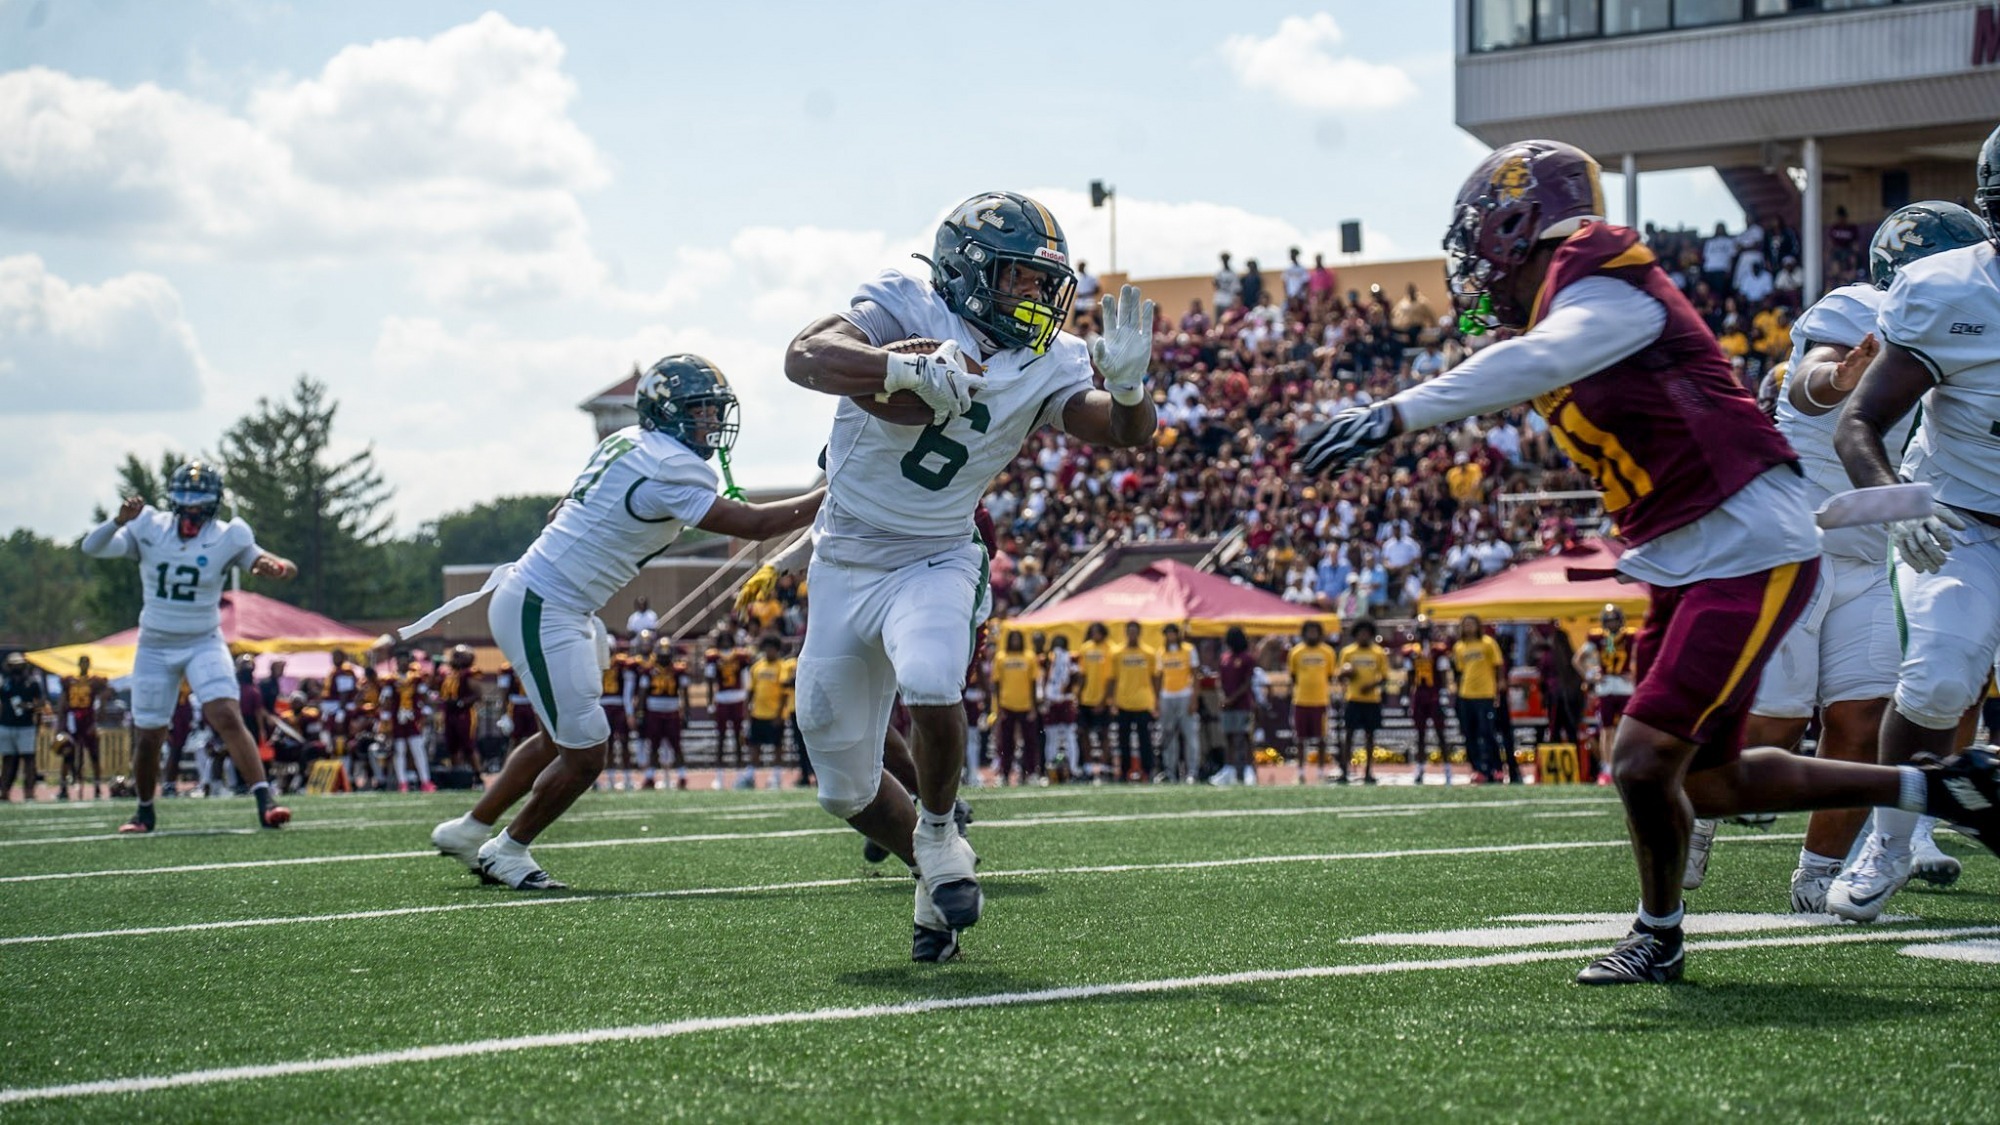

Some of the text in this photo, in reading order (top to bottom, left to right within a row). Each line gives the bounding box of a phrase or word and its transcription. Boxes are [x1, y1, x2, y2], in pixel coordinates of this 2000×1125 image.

[1878, 219, 1917, 251] K
[900, 400, 991, 492] 6
[156, 562, 200, 602] 12
